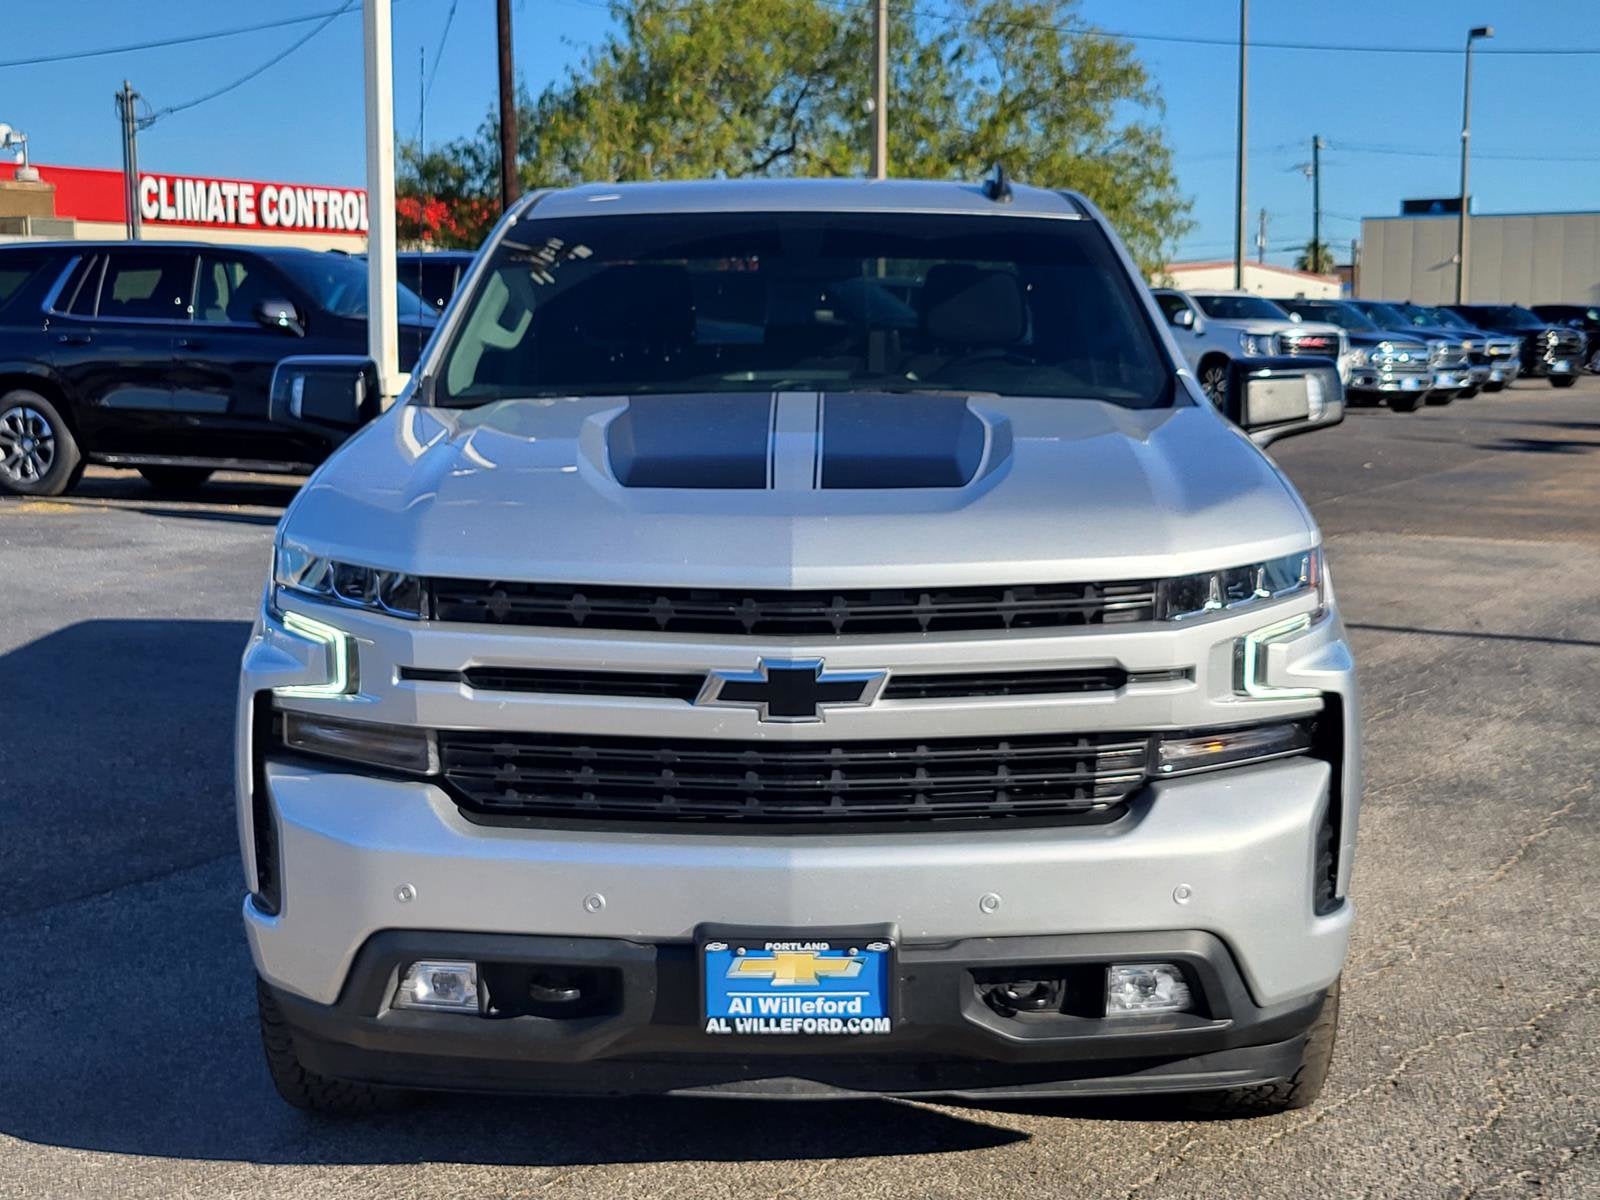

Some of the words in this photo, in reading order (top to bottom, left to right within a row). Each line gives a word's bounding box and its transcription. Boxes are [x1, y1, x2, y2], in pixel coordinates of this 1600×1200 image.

[140, 176, 256, 225] CLIMATE
[765, 943, 829, 951] PORTLAND
[728, 997, 752, 1014] Al
[758, 997, 862, 1014] Willeford
[706, 1018, 732, 1034] AL
[735, 1018, 891, 1034] WILLEFORD.COM
